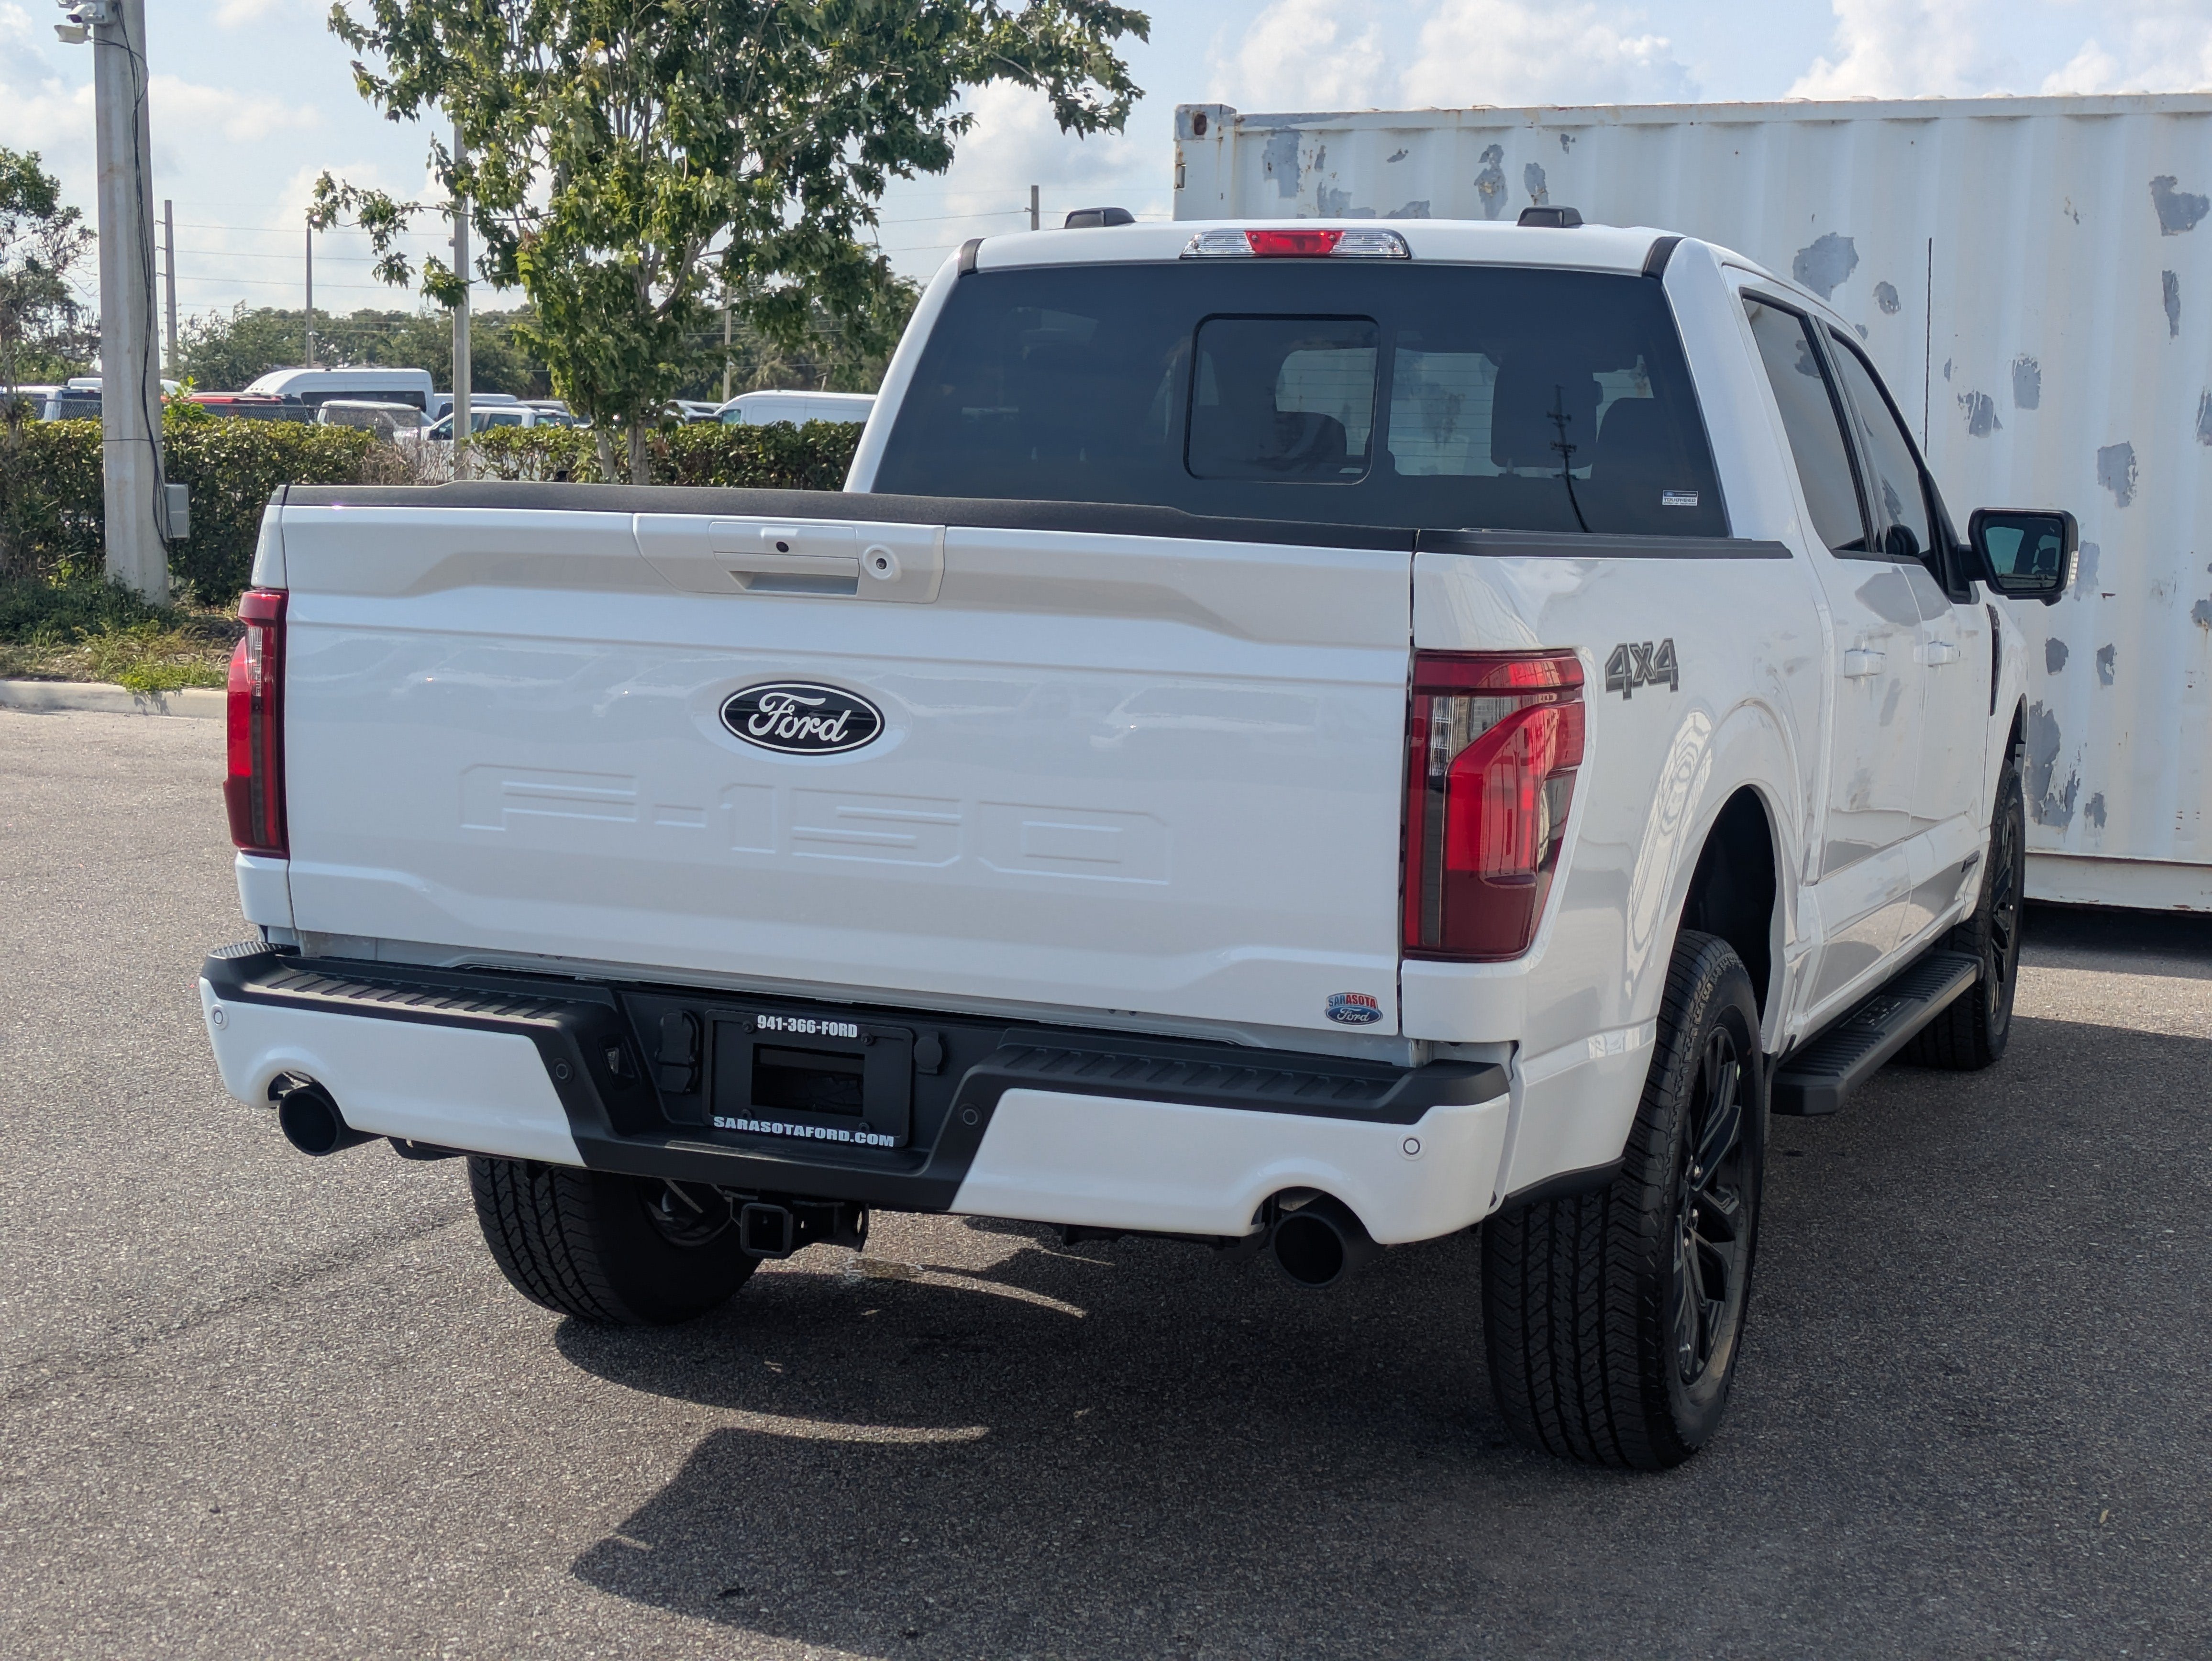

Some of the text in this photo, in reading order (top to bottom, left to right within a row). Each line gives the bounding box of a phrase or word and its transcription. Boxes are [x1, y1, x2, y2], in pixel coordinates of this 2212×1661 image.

[748, 692, 852, 742] Ford
[459, 763, 1172, 885] F-150
[1328, 995, 1376, 1009] SARASOTA
[1337, 1007, 1370, 1022] Ford
[757, 1015, 858, 1038] 941-366-FORD
[713, 1116, 894, 1147] SARASOTAFORD.COM
